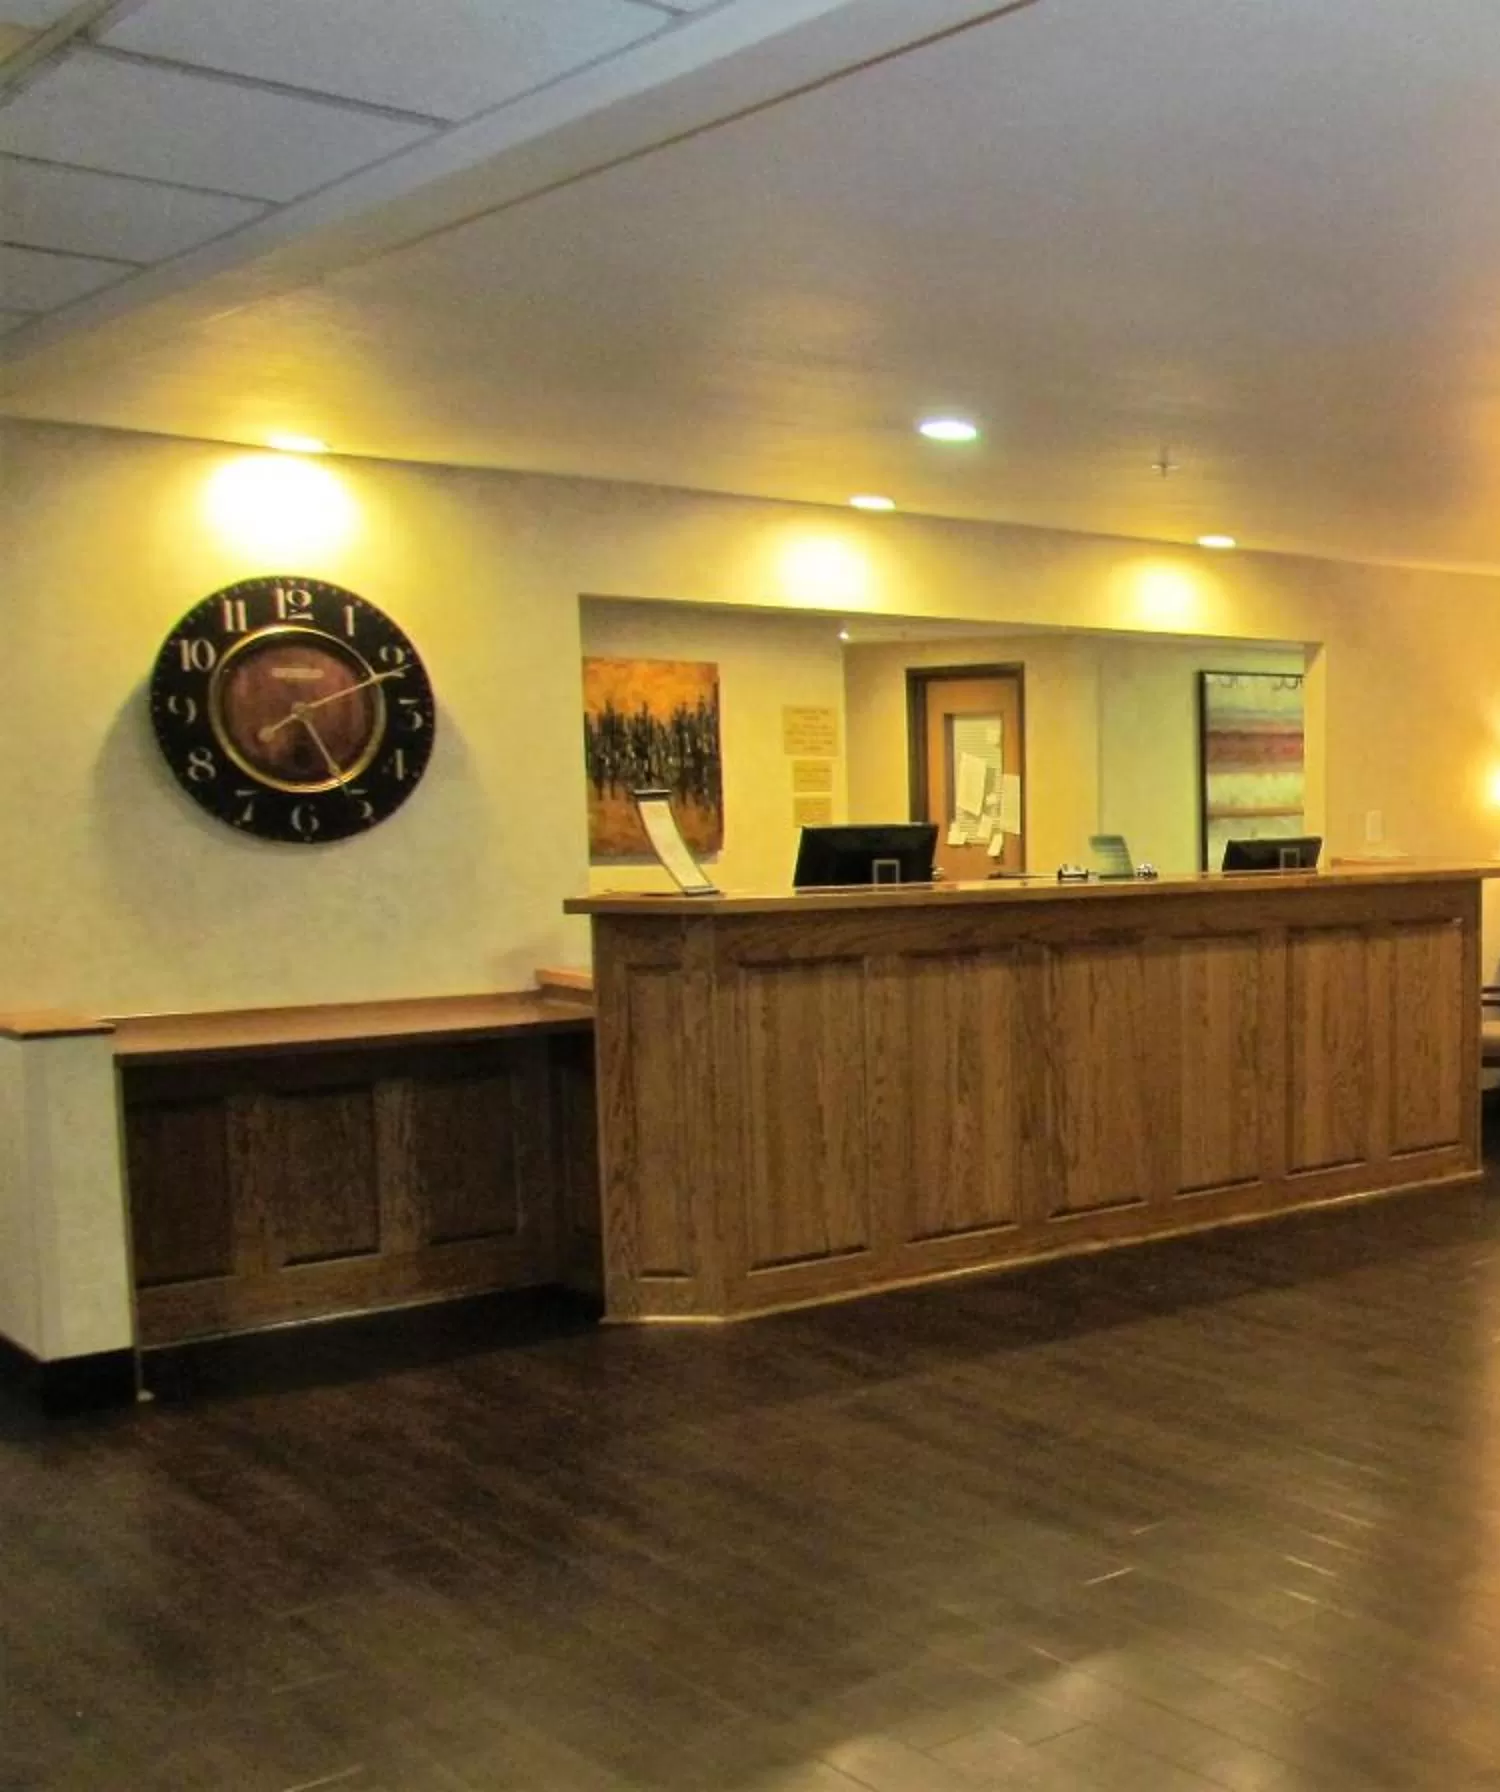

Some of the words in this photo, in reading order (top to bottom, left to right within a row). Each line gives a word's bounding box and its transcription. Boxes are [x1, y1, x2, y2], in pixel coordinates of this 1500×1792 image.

[223, 600, 247, 632] 11
[277, 587, 314, 620] 12
[344, 604, 355, 637] 1
[179, 639, 216, 672] 10
[168, 695, 196, 724] 9
[399, 698, 423, 731] 3
[187, 748, 216, 781] 8
[234, 788, 259, 825] 7
[291, 803, 320, 834] 6
